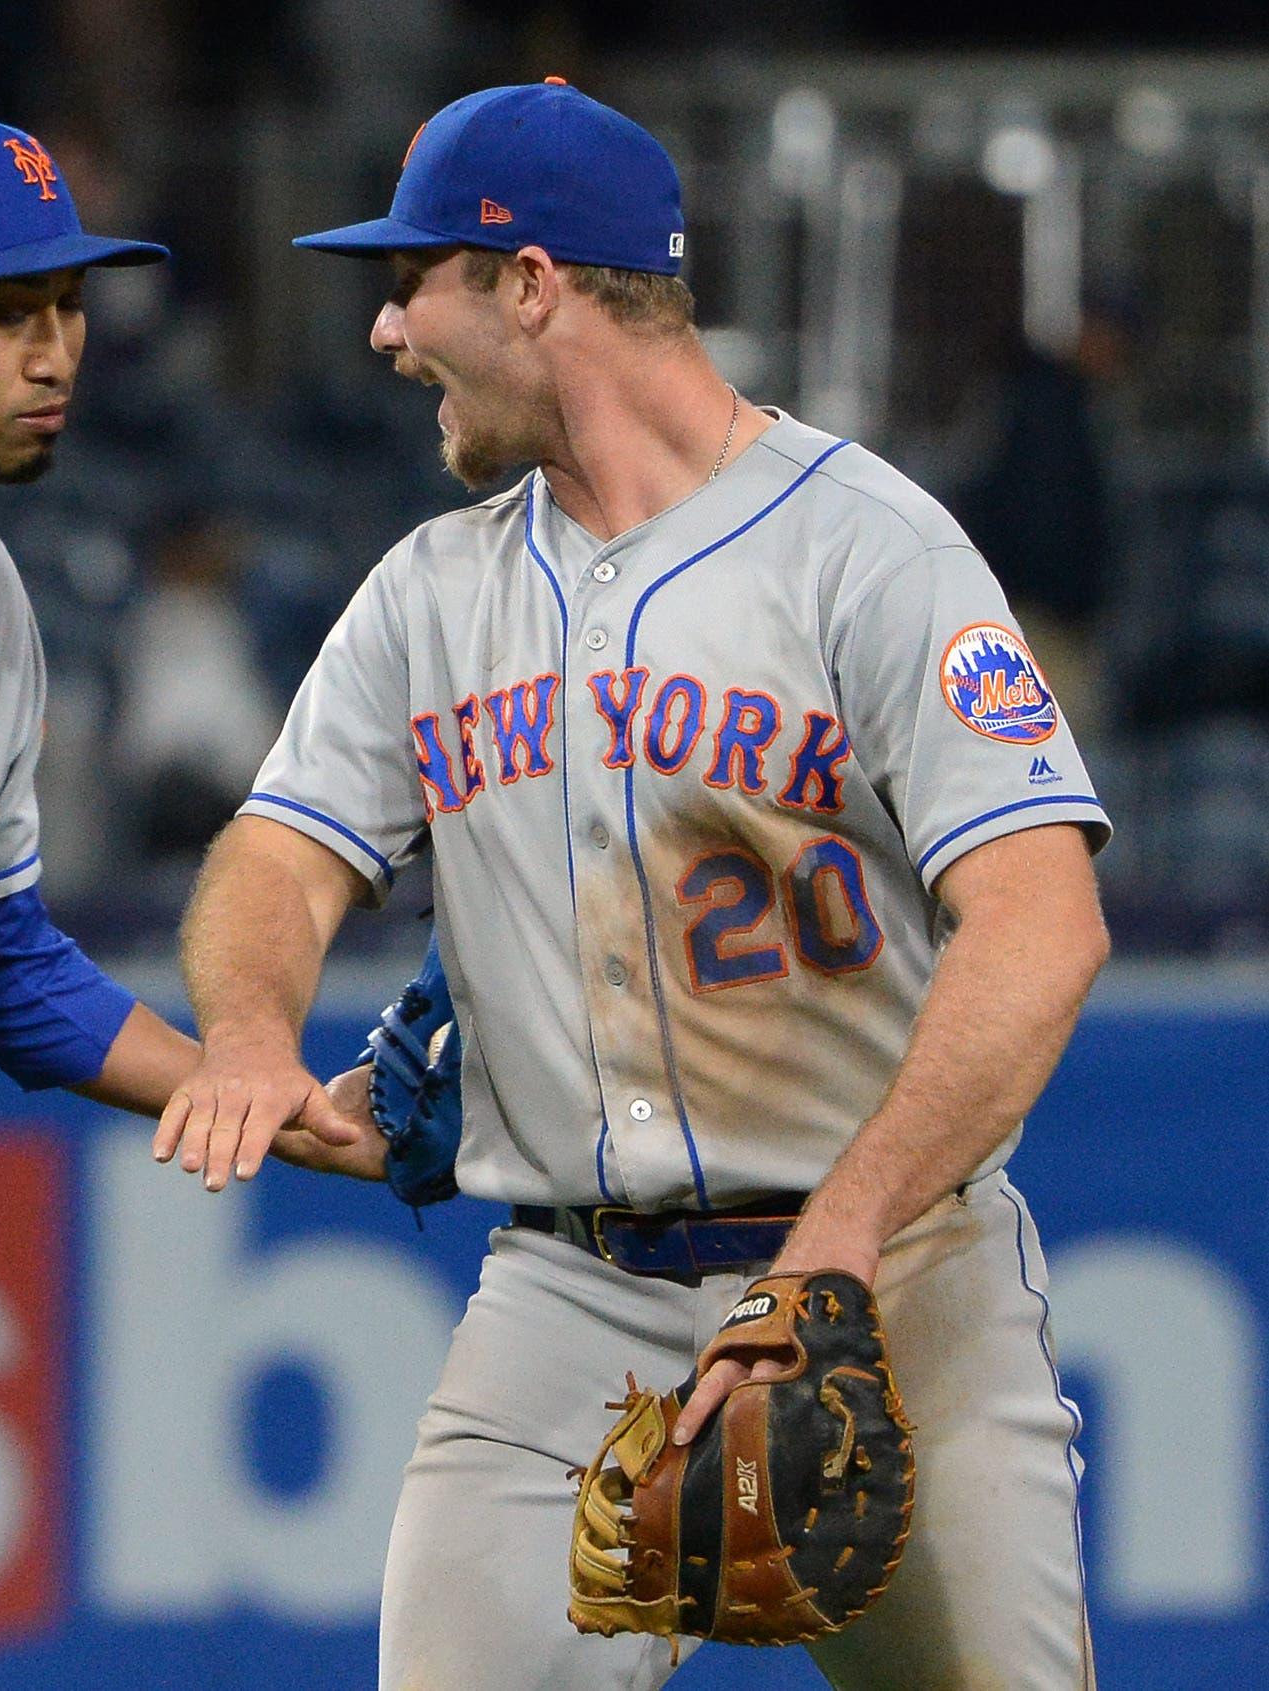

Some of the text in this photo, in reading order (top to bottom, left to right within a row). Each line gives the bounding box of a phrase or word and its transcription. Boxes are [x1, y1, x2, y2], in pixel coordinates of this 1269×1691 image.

[411, 666, 851, 823] NEW YORK
[971, 669, 1043, 718] Mets
[674, 834, 884, 996] 20
[736, 1456, 758, 1516] A2K
